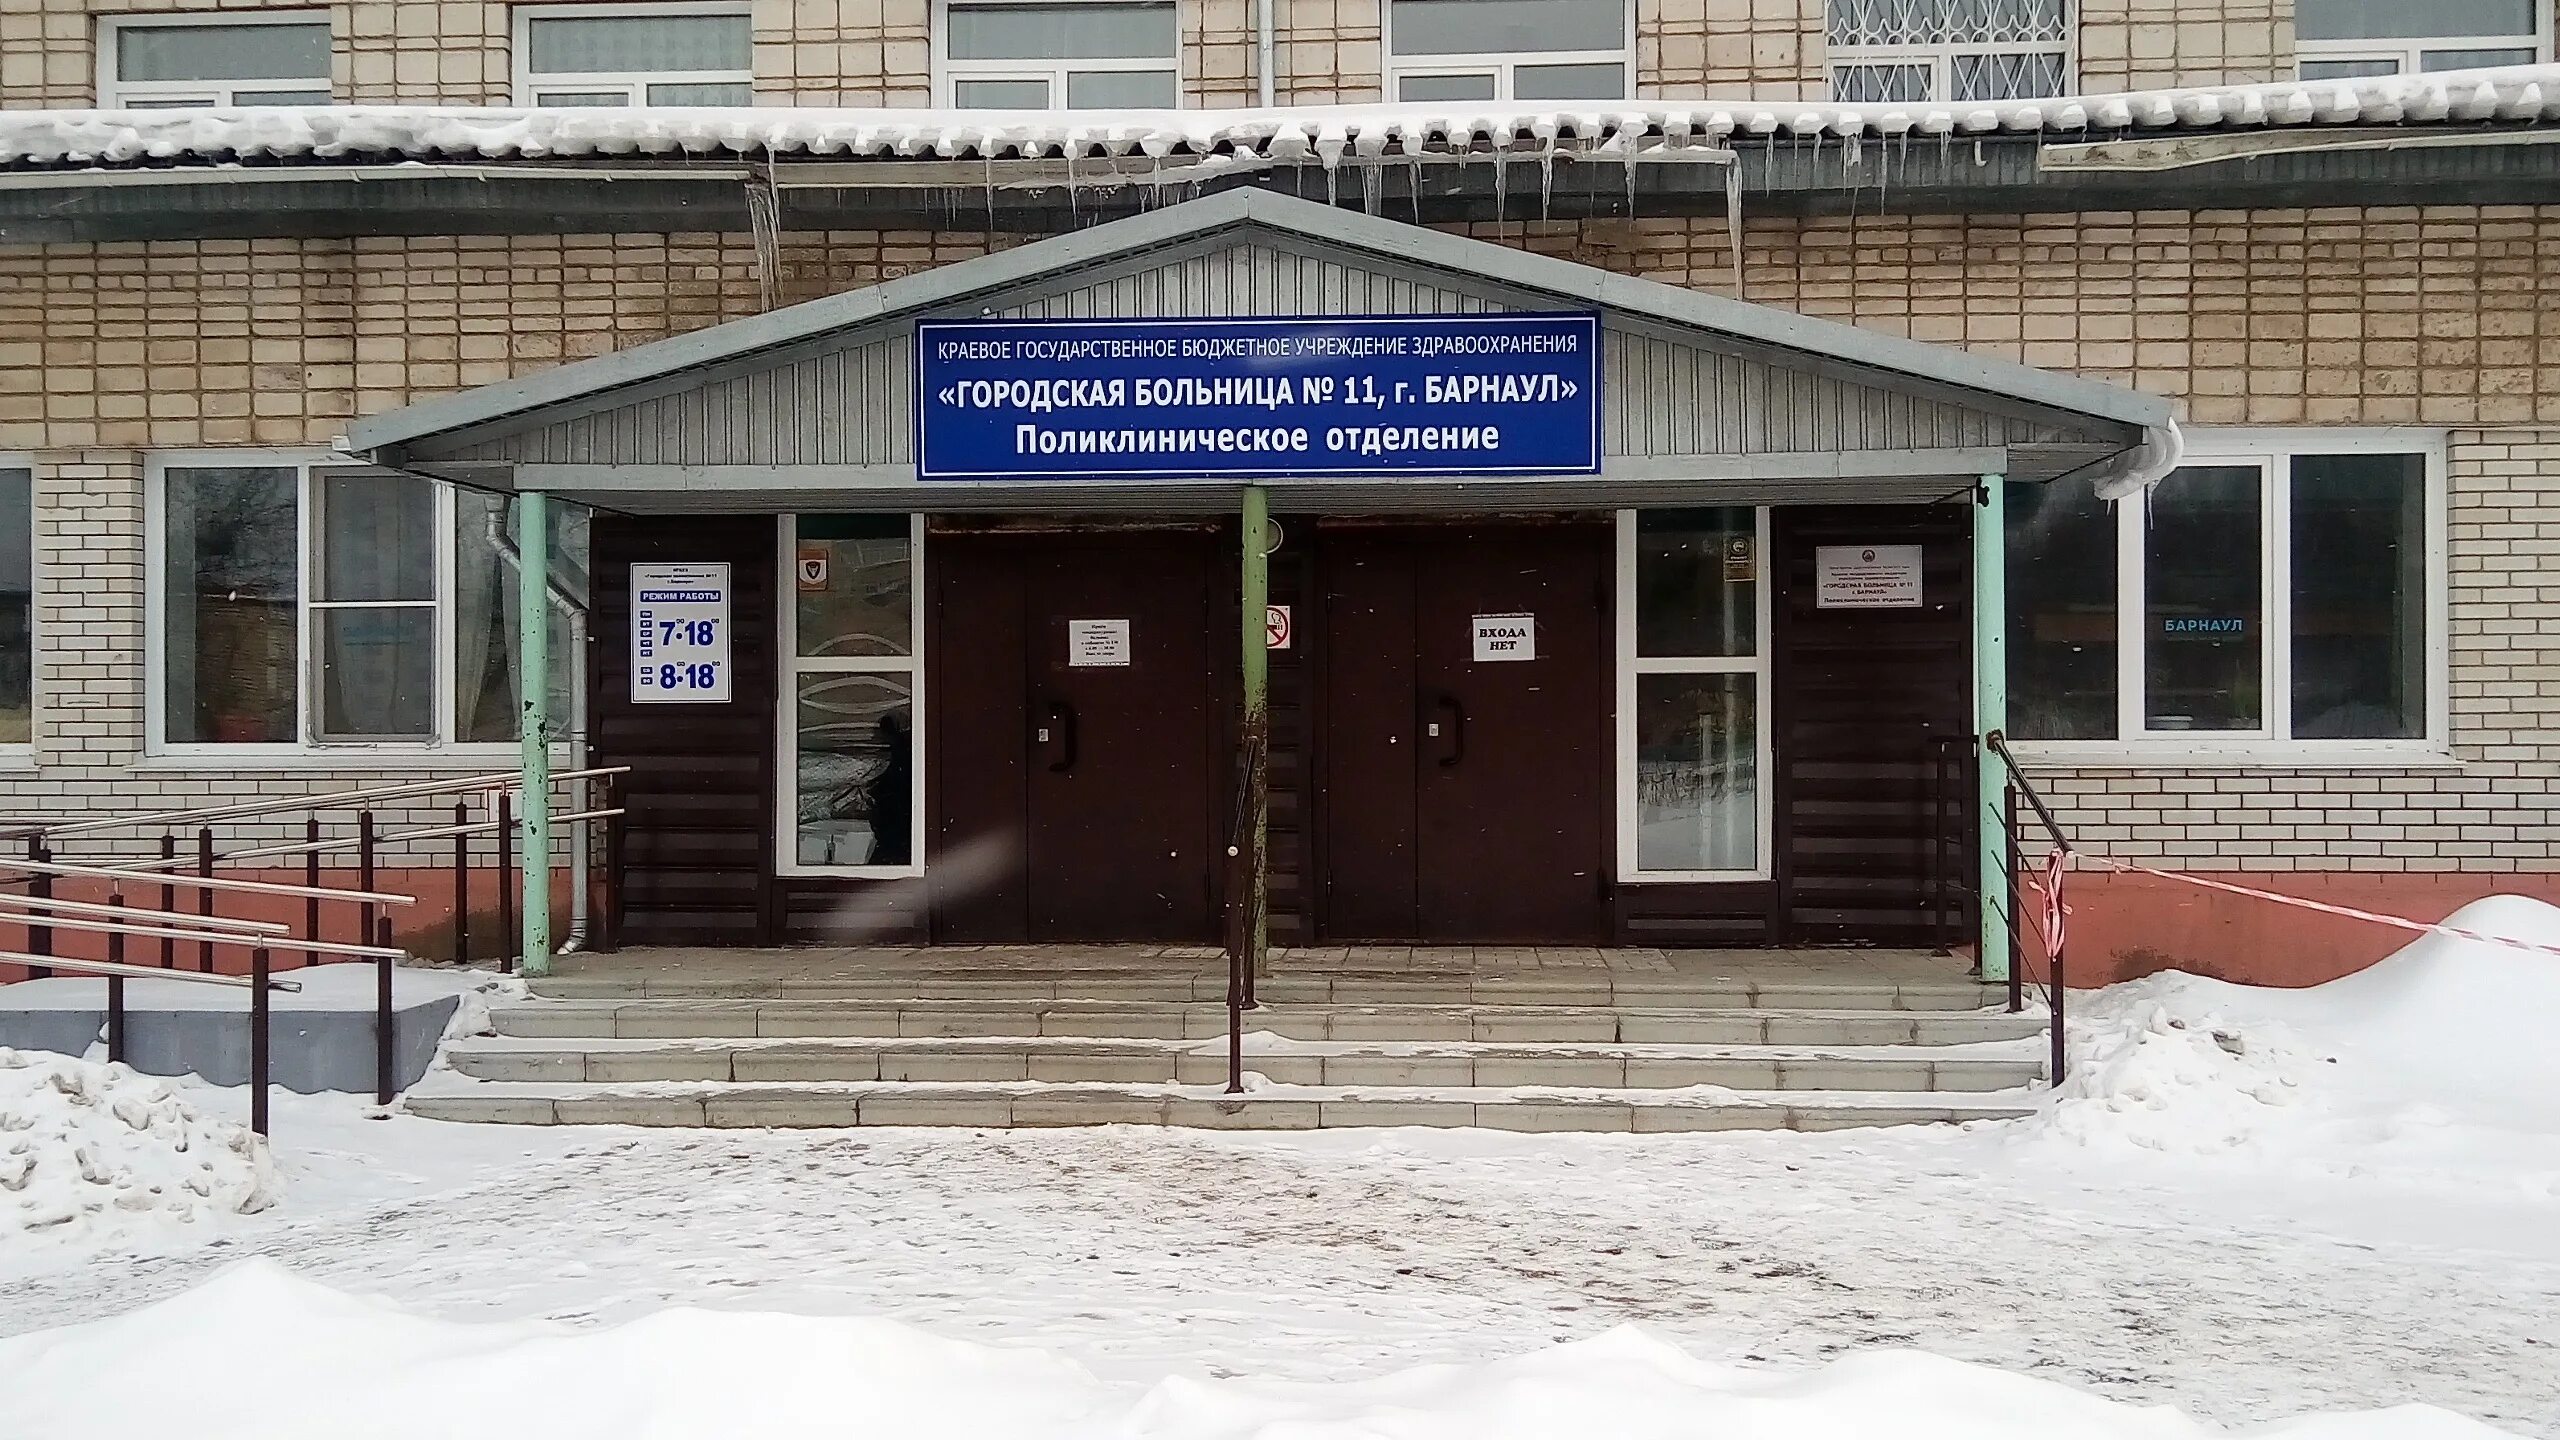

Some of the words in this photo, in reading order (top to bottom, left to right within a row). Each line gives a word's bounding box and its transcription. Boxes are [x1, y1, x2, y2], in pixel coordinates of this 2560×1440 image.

[938, 341, 1011, 359] КРАЕВОЕ
[1016, 339, 1177, 361] ГОСУДАРСТВЕННОЕ
[1182, 338, 1290, 359] БЮДЖЕТНОЕ
[1295, 336, 1407, 358] УЧРЕЖДЕНИЕ
[1412, 335, 1577, 357] ЗДРАВООХРАНЕНИЯ
[938, 379, 1125, 413] «ГОРОДСКАЯ
[1135, 377, 1294, 411] БОЛЬНИЦА
[1303, 376, 1334, 404] №
[1344, 375, 1386, 410] 11,
[1395, 381, 1416, 404] г.
[1425, 374, 1578, 404] БАРНАУЛ»
[1016, 425, 1309, 454] Поликлиническое
[1326, 426, 1499, 455] отделение
[643, 592, 678, 600] РЕЖИМ
[679, 592, 719, 600] РАБОТЫ
[2165, 619, 2243, 631] БАРНАУЛ
[1479, 628, 1527, 638] ВХОДА
[1489, 641, 1517, 650] НЕТ
